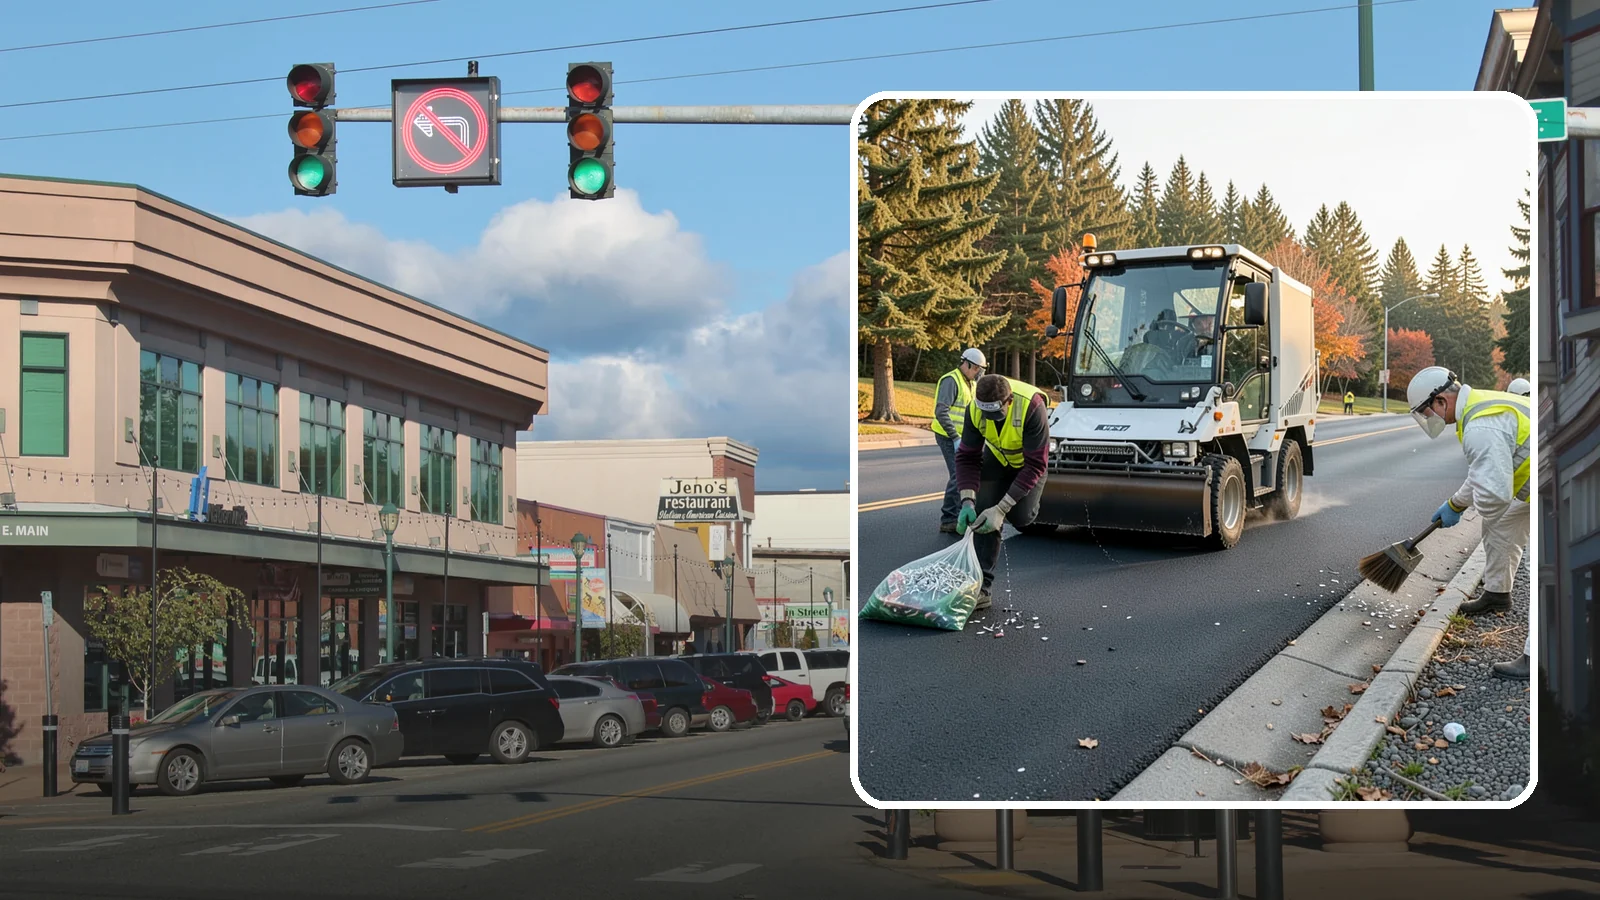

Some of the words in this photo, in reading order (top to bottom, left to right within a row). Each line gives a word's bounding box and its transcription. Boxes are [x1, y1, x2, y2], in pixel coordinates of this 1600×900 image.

[670, 480, 727, 494] Jeno's
[665, 496, 731, 509] restaurant
[686, 510, 714, 519] American
[715, 510, 737, 519] Cuisine
[2, 525, 13, 536] E.
[15, 525, 49, 536] MAIN
[797, 608, 828, 616] Street
